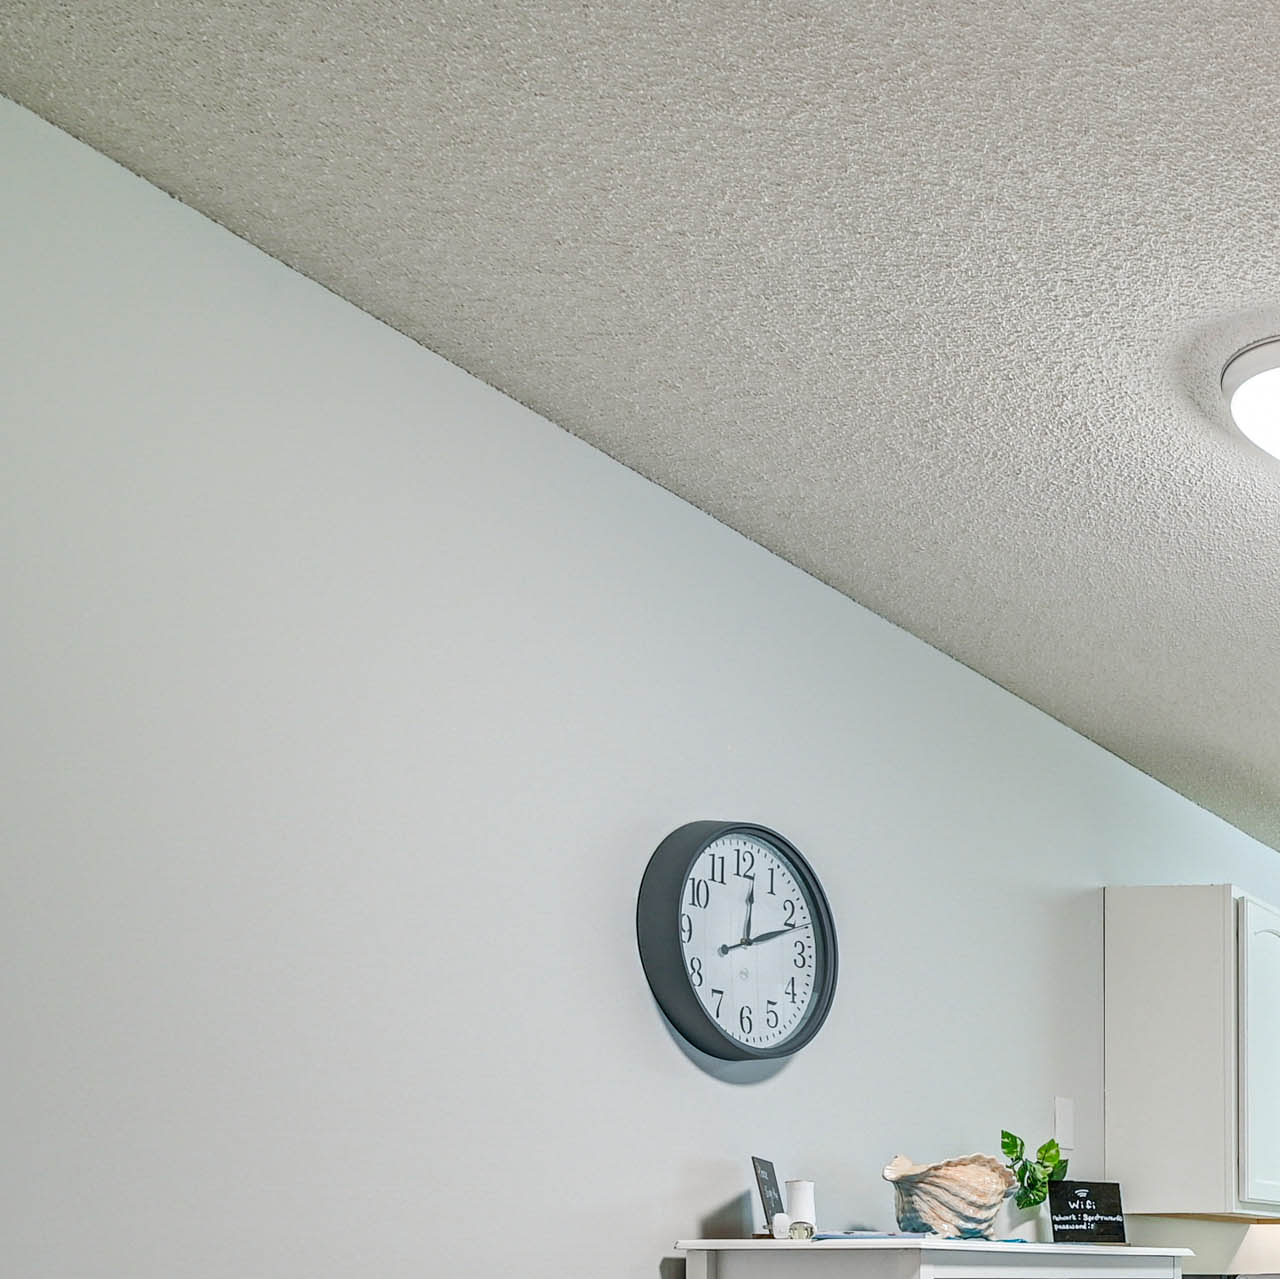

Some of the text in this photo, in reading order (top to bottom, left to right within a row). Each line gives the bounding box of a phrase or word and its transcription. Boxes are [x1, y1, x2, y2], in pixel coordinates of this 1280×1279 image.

[709, 854, 727, 885] 11
[734, 849, 755, 880] 12
[689, 877, 709, 909] 10
[767, 868, 776, 895] 1
[681, 913, 692, 943] 9
[784, 900, 796, 928] 2
[793, 941, 806, 968] 3
[690, 957, 703, 987] 8
[711, 989, 724, 1019] 7
[784, 977, 797, 1004] 4
[739, 1005, 753, 1034] 6
[766, 1000, 779, 1028] 5
